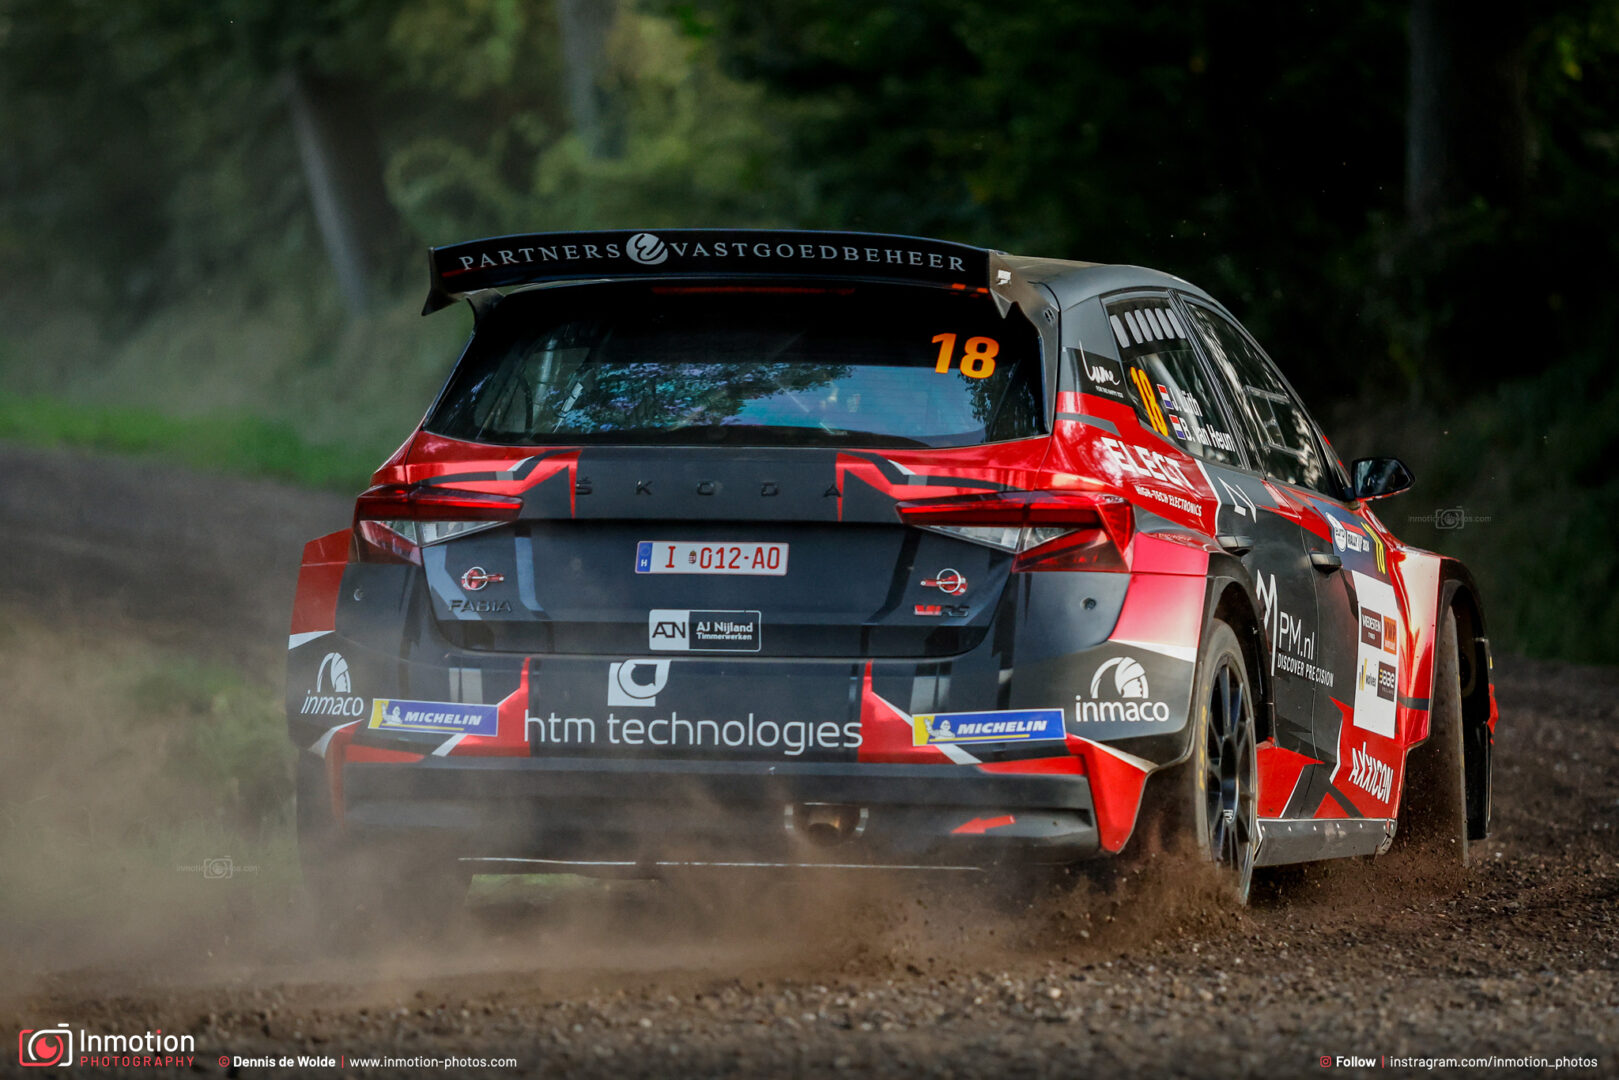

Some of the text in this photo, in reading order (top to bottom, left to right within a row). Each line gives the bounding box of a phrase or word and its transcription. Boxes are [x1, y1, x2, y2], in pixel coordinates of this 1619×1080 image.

[459, 241, 967, 272] PARTNERS VASTGOEDBEHEER
[930, 332, 1000, 379] 18
[1130, 366, 1169, 438] 18
[1101, 436, 1195, 491] ELECT
[1168, 494, 1203, 517] ELECTRONICS
[448, 600, 512, 614] FABIA
[696, 621, 753, 635] AJ Nijland
[696, 632, 753, 640] Timmerwerken
[1278, 653, 1335, 688] DISCOVER PRECISION
[300, 690, 364, 717] inmaco
[1075, 695, 1170, 722] inmaco
[404, 711, 483, 726] MICHELIN
[957, 720, 1047, 735] MICHELIN
[524, 709, 863, 756] htm technologies
[1348, 741, 1394, 804] AXXICON
